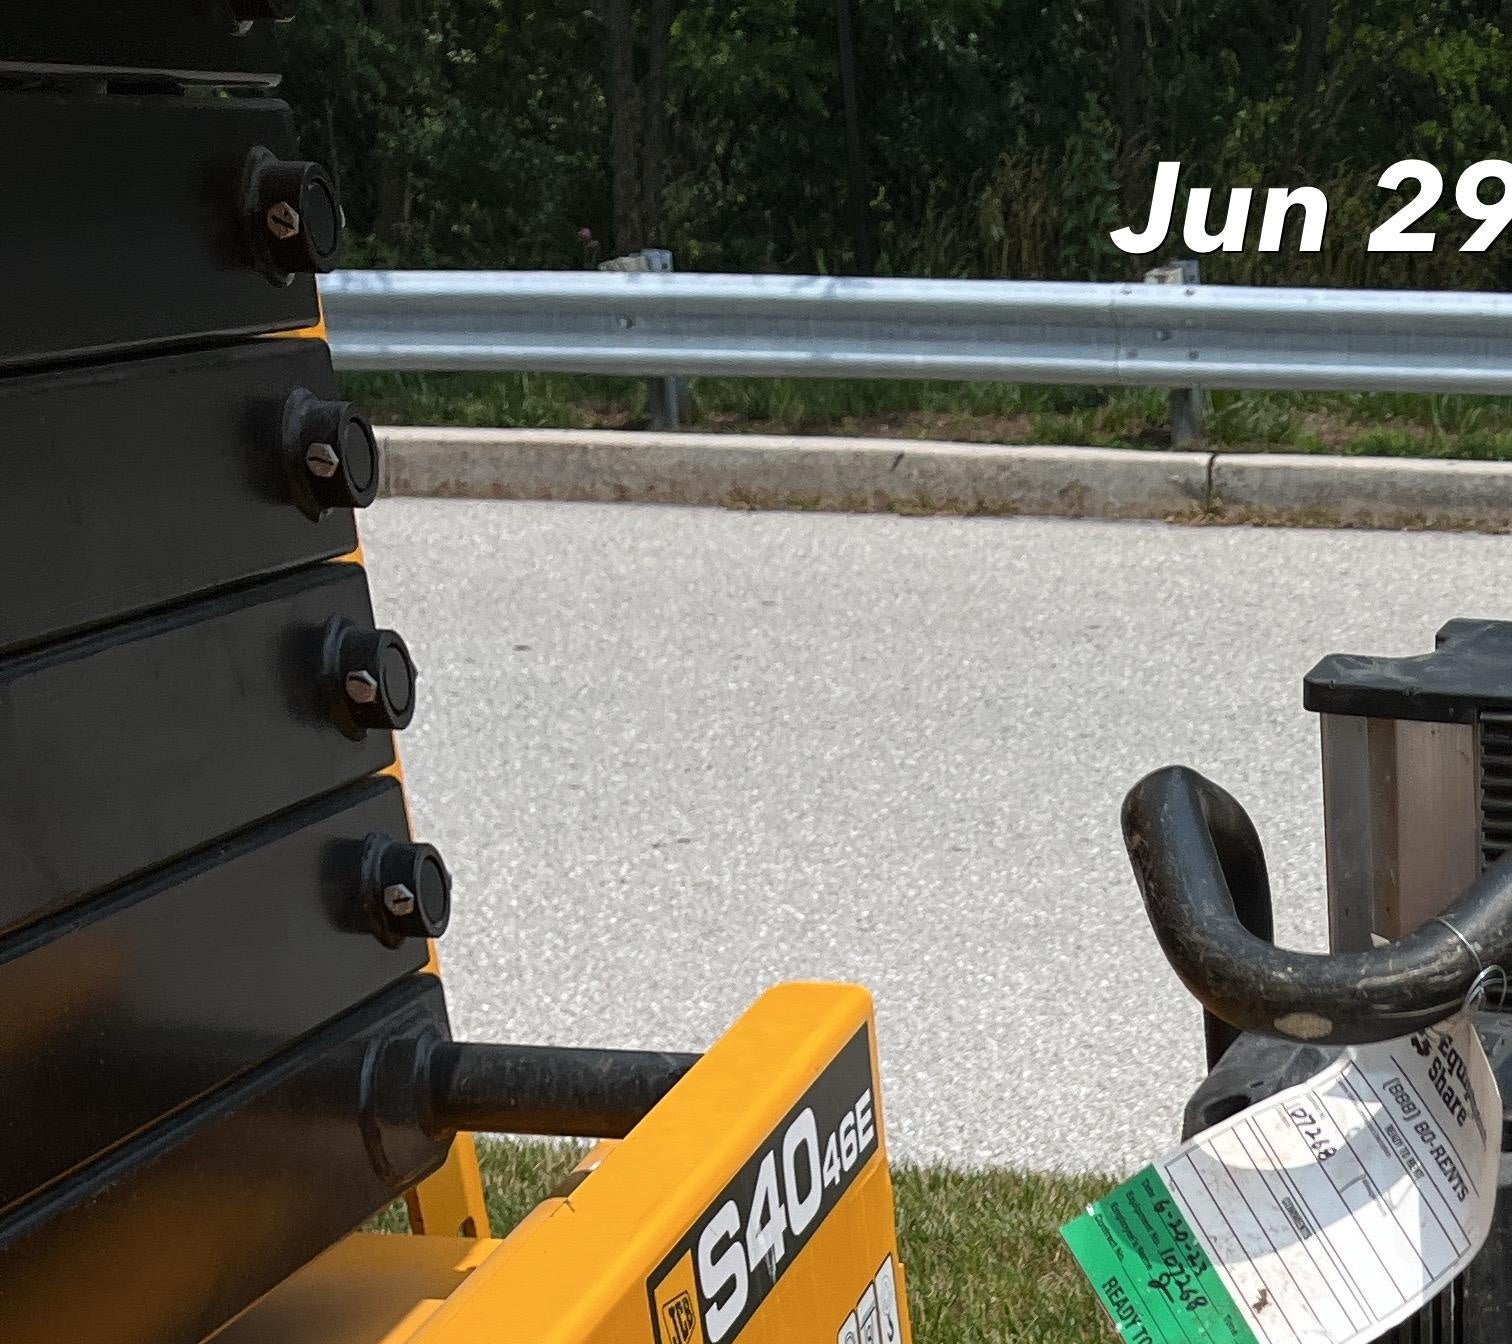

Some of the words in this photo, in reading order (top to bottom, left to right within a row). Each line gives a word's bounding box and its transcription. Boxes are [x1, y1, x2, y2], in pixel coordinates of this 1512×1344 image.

[1426, 1056, 1468, 1127] Share
[1382, 1076, 1411, 1121] (888)
[1412, 1119, 1472, 1204] 80-RENTS
[698, 1107, 822, 1344] S40
[823, 1087, 876, 1189] 46E
[1100, 1276, 1141, 1330] READY
[1154, 1245, 1209, 1315] 107268
